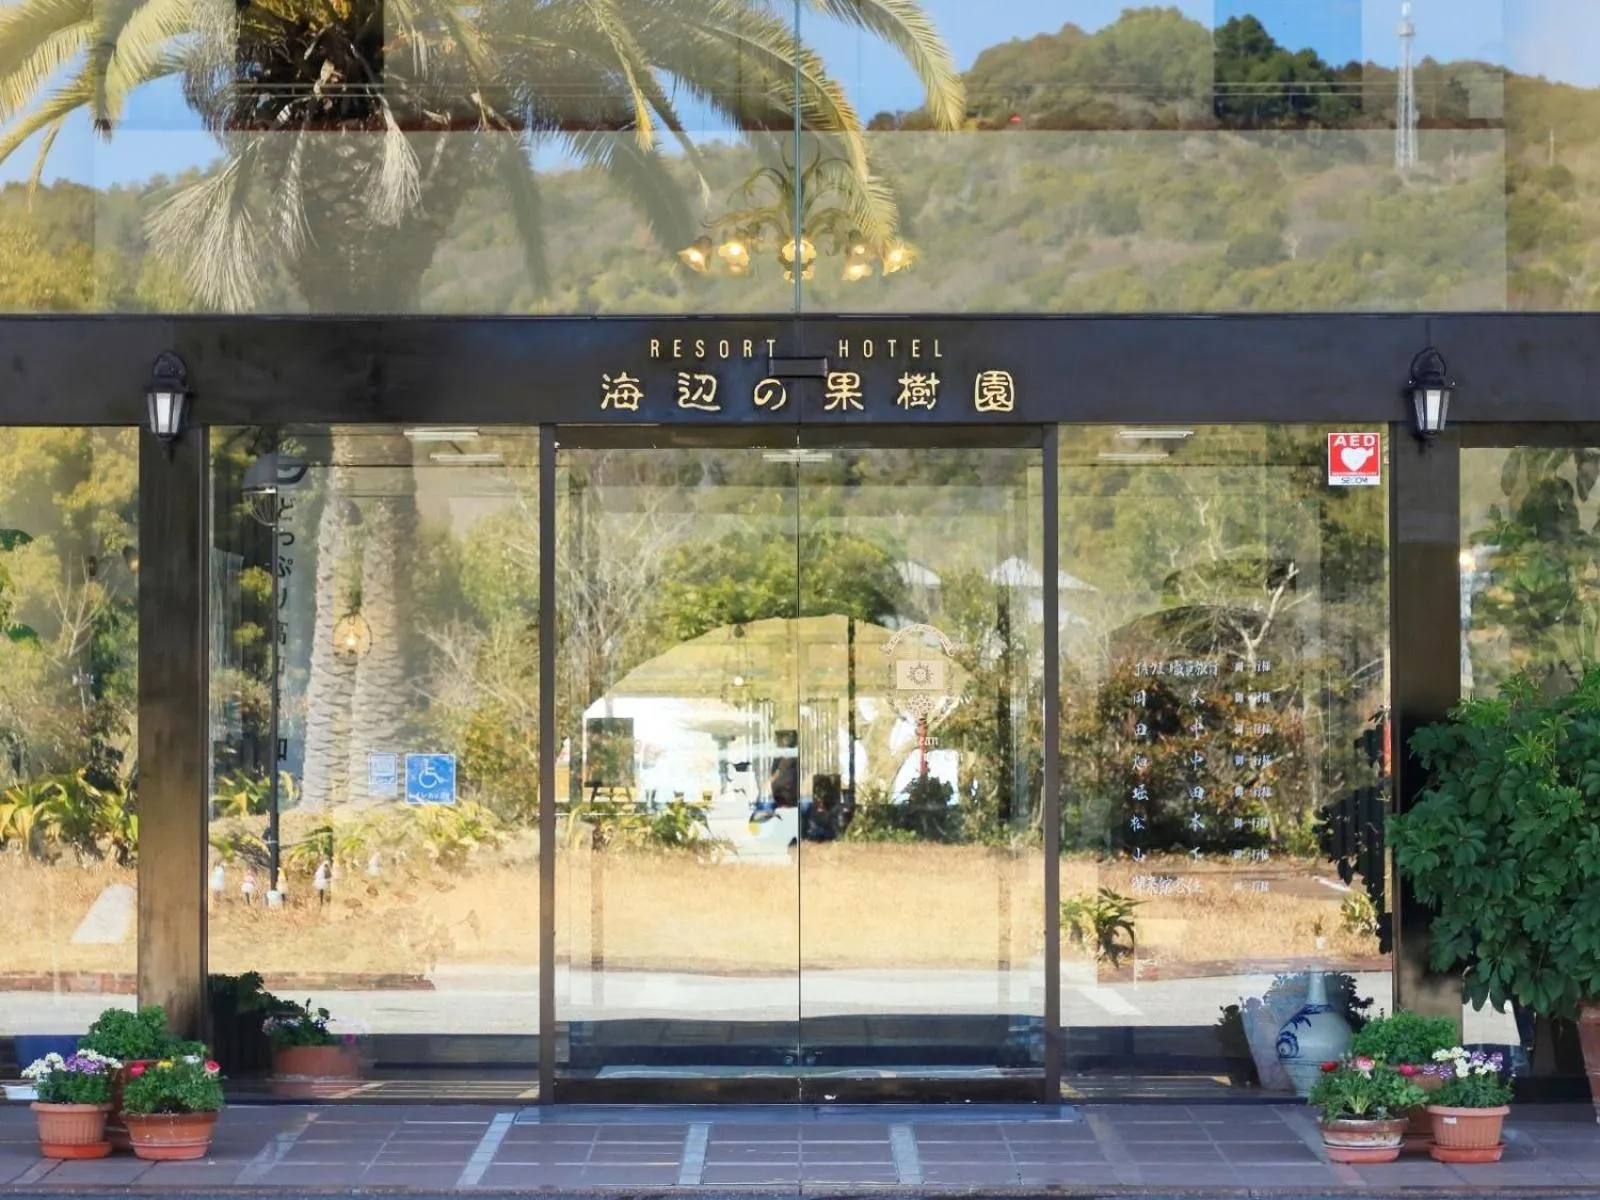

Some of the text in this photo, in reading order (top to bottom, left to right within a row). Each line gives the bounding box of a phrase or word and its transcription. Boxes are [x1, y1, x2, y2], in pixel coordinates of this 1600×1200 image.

[650, 339, 944, 358] RESORT HOTEL
[600, 370, 1015, 413] 海辺の果樹園
[1333, 435, 1376, 447] AED
